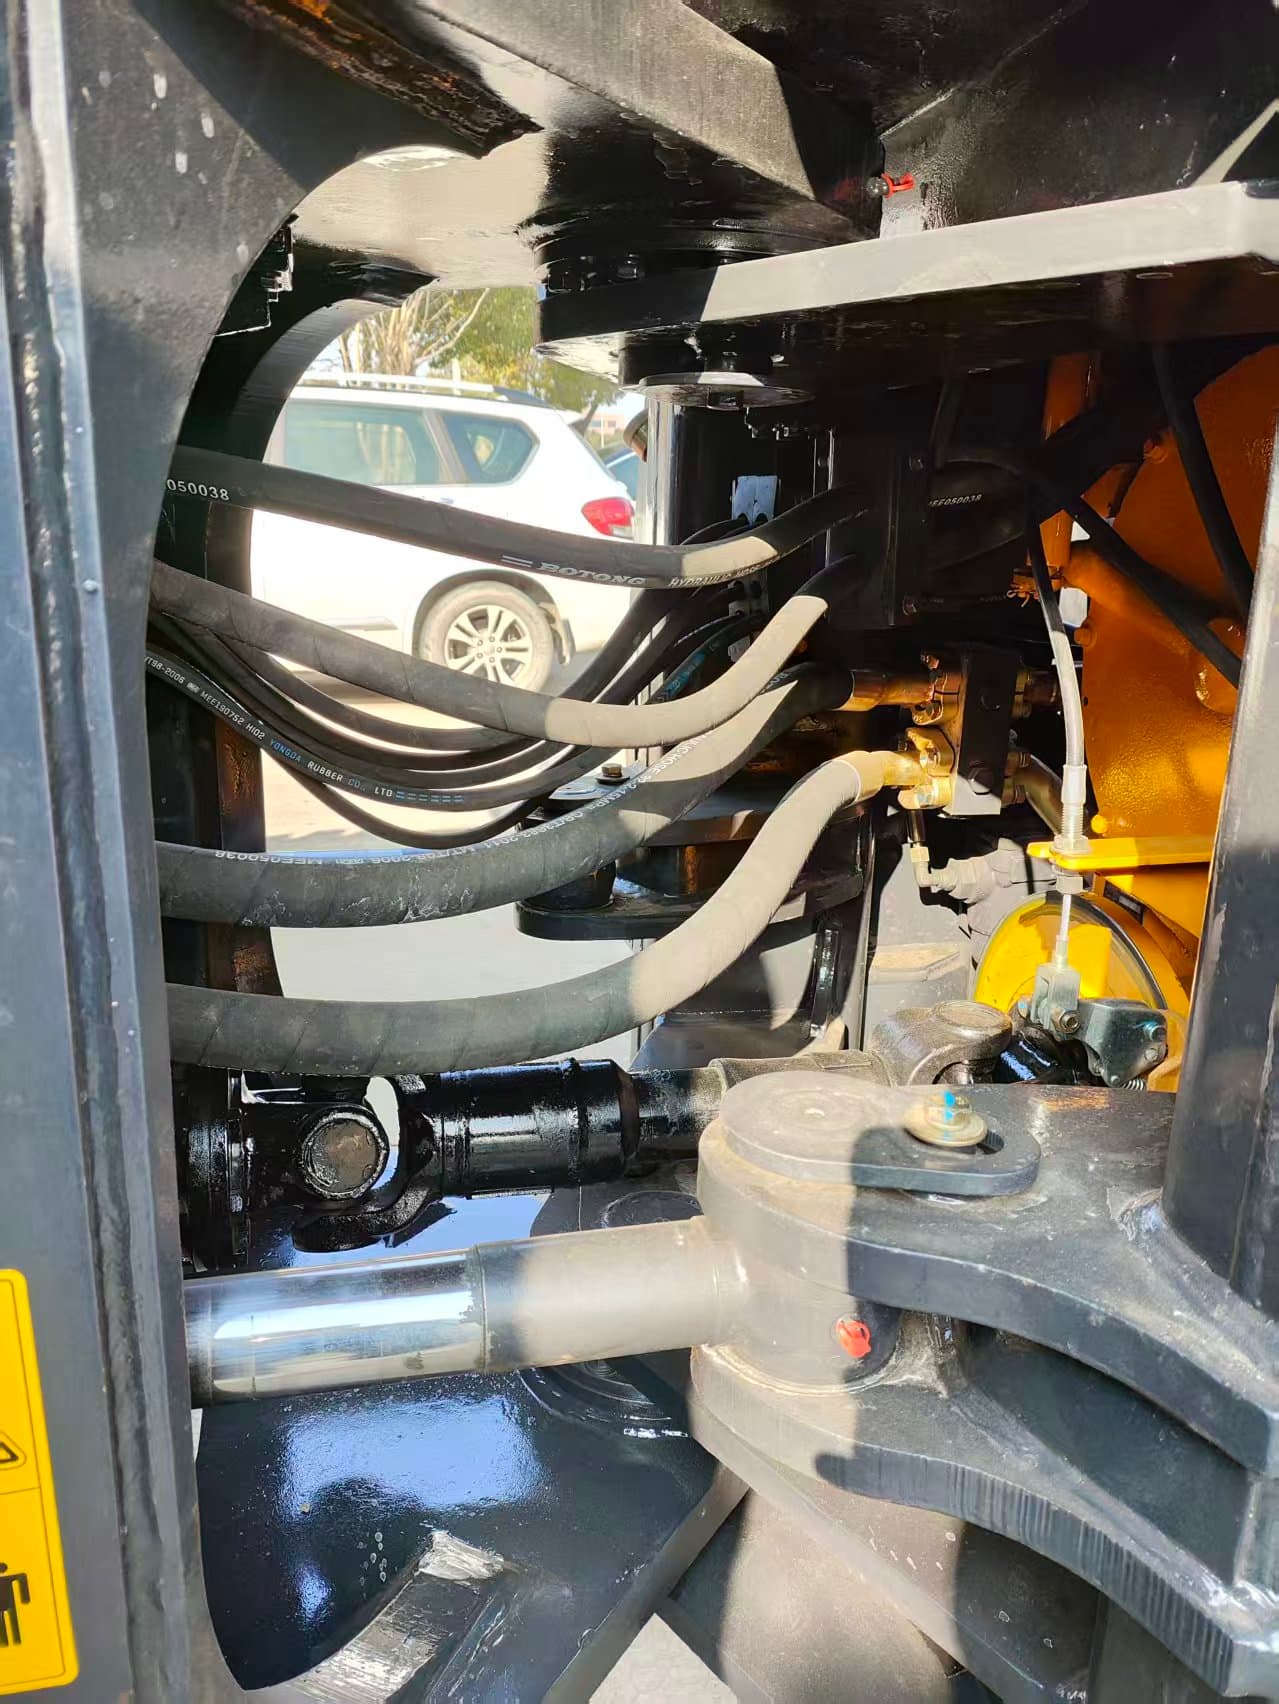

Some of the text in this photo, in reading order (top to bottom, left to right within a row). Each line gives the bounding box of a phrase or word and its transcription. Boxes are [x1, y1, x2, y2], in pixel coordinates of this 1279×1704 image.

[166, 479, 230, 501] 050038
[536, 562, 646, 585] BOTONG
[201, 691, 245, 726] MEE190752
[270, 738, 302, 763] YONGDA
[307, 760, 344, 783] RUBBER
[374, 786, 394, 798] LTD
